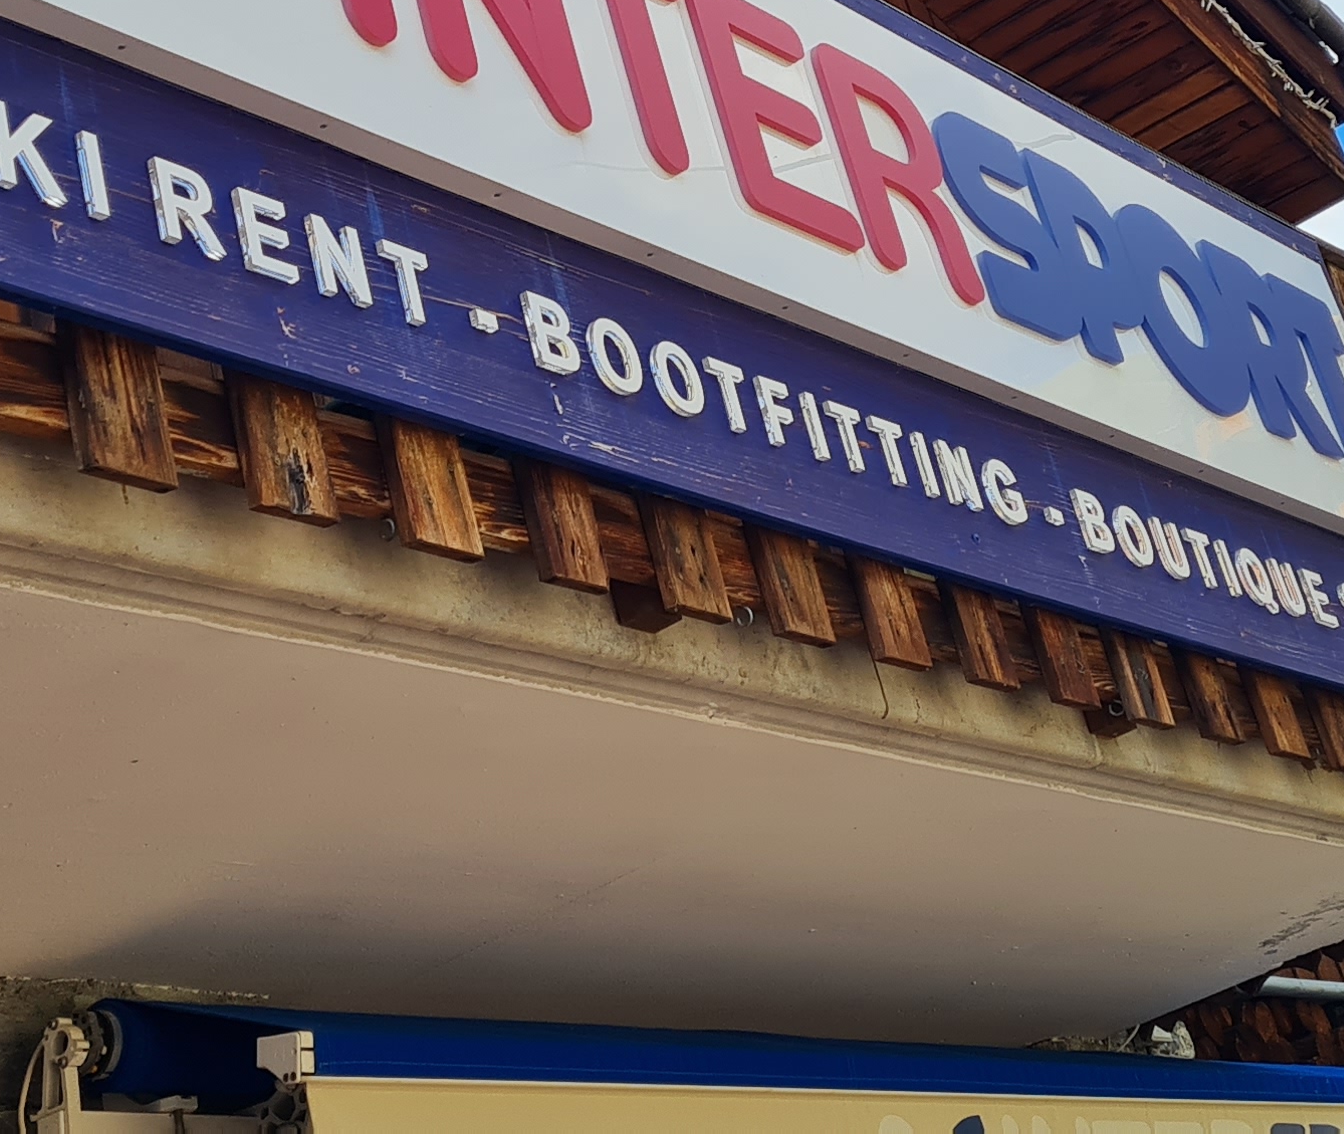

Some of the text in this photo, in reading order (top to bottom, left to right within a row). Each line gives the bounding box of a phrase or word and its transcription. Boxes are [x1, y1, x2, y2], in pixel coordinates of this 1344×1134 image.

[148, 155, 429, 327] RENT
[518, 290, 1029, 526] BOOTFITTING
[1069, 488, 1341, 630] BOUTIQUE
